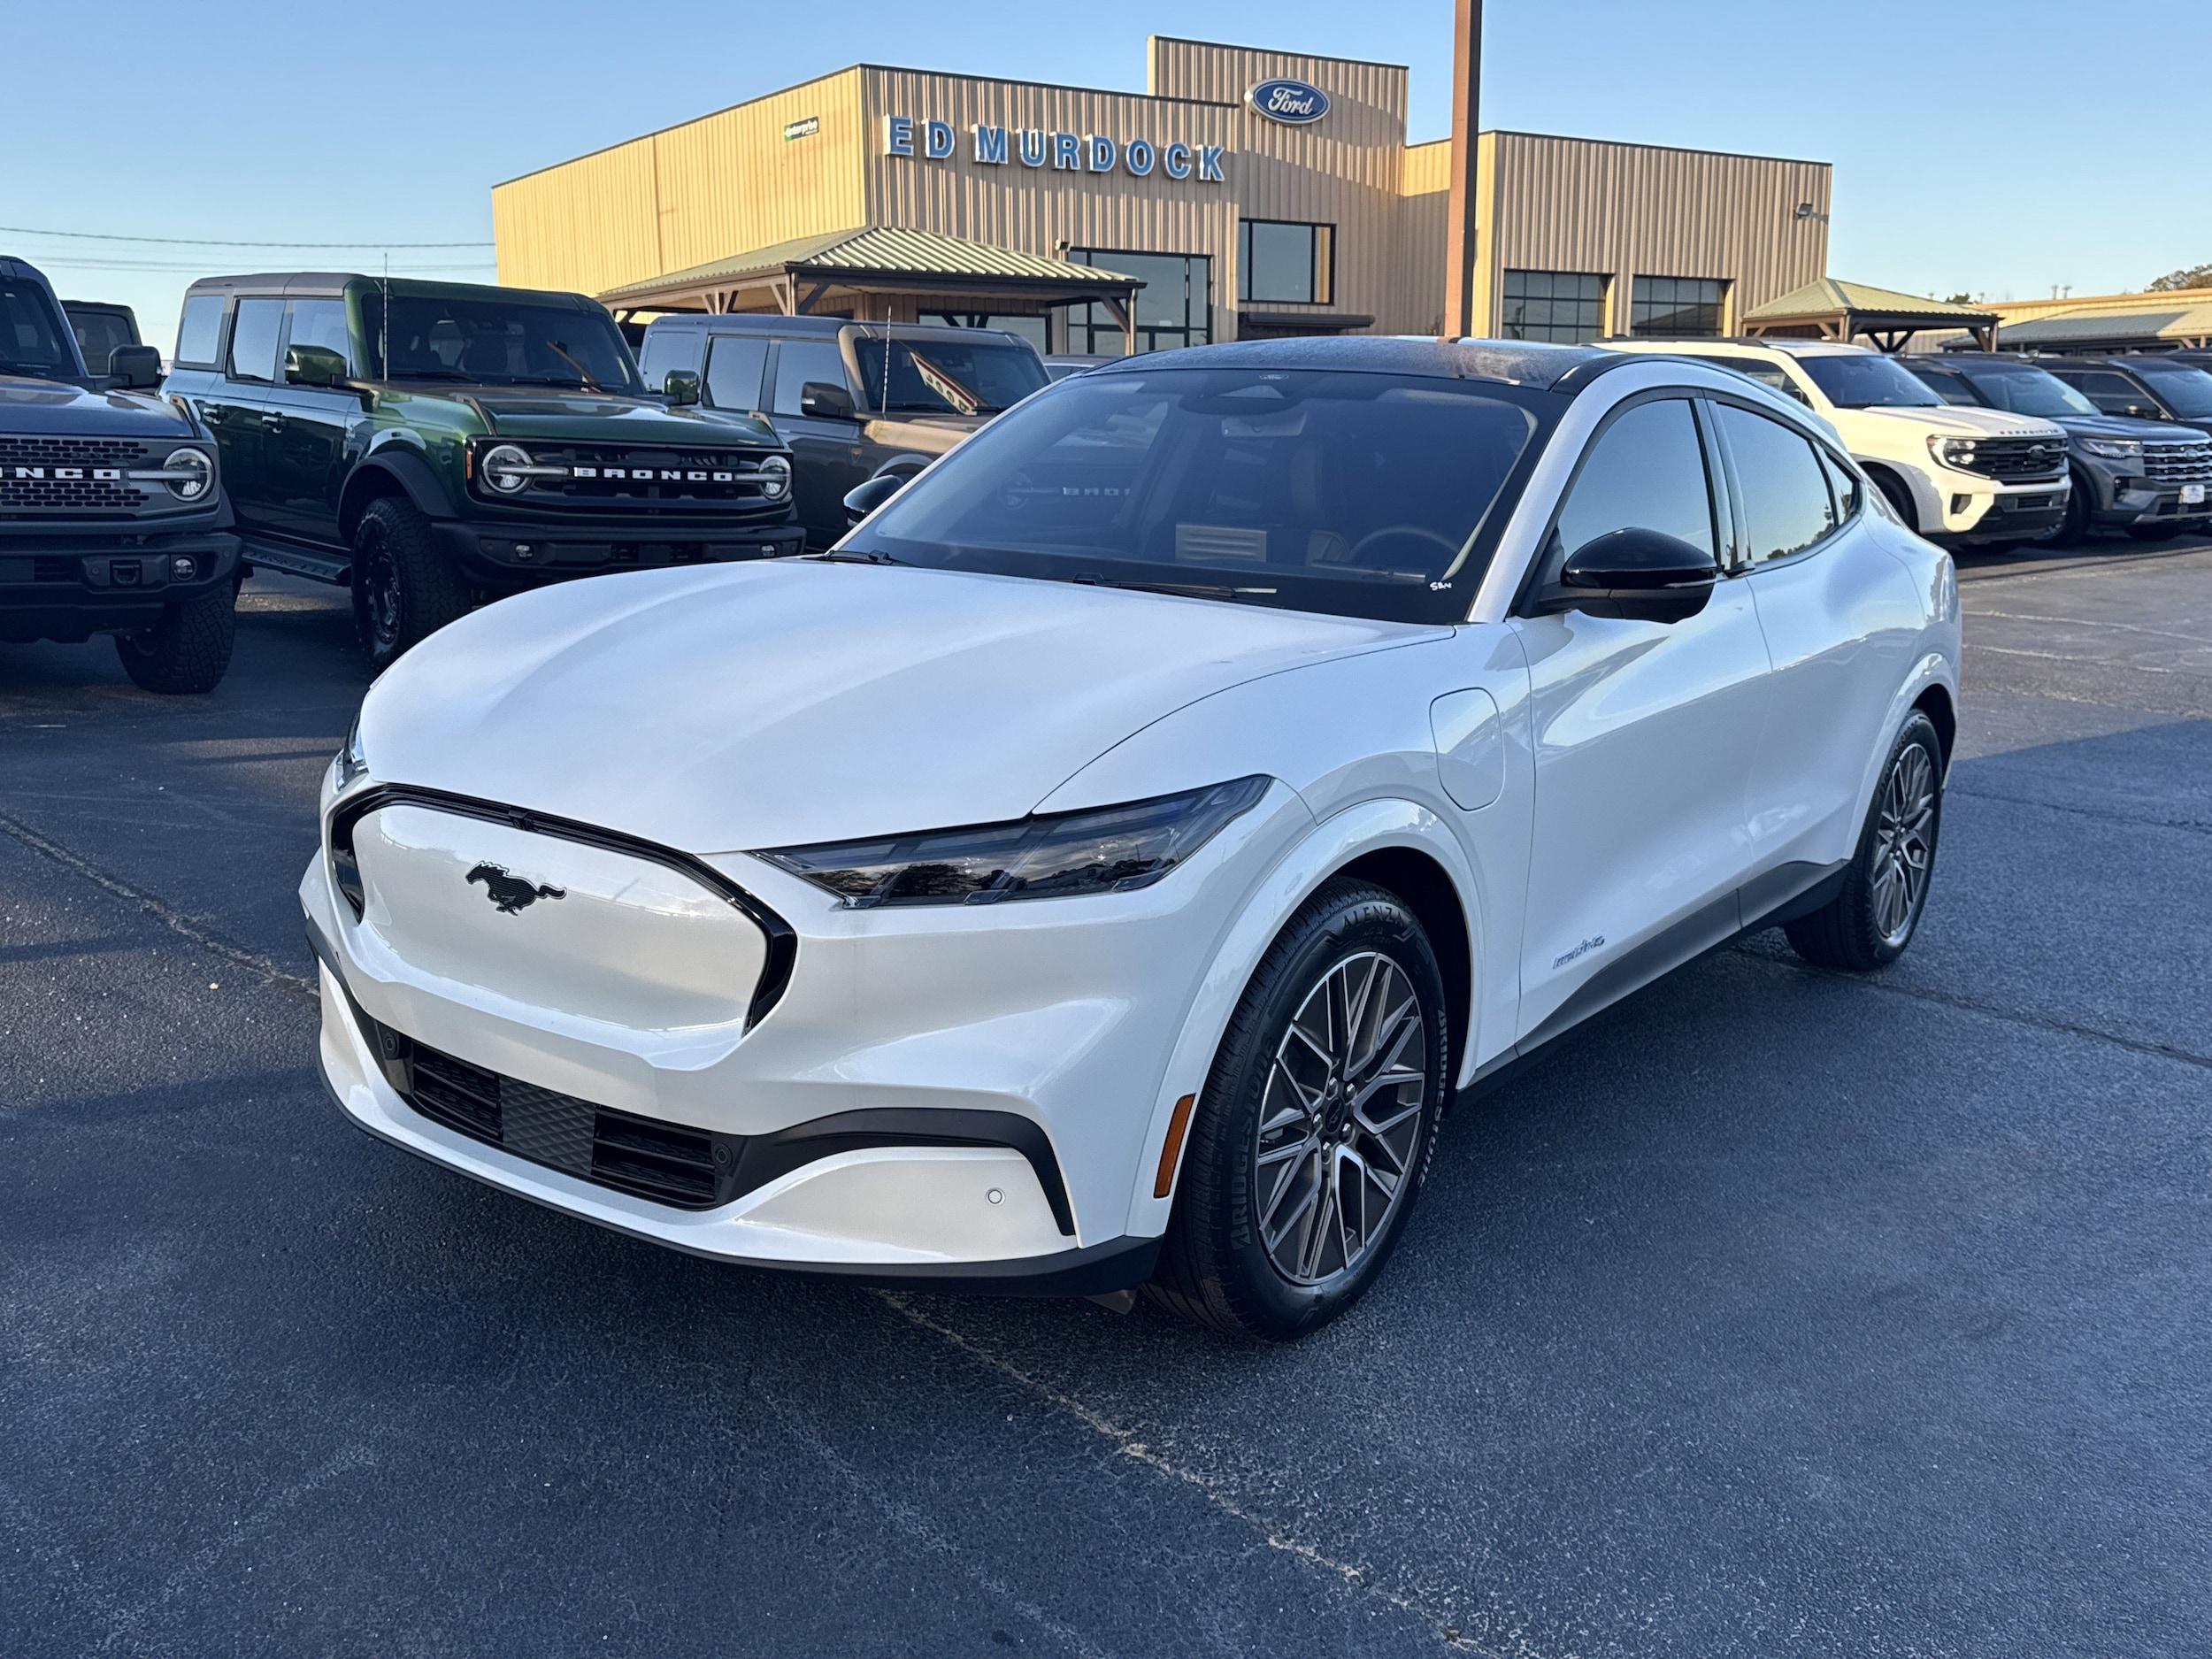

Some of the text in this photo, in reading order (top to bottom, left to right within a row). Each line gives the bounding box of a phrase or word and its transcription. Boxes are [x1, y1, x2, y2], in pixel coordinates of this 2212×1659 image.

[1268, 87, 1314, 115] Ford
[885, 113, 1225, 182] ED MURDOCK
[0, 466, 121, 480] NCO
[574, 466, 733, 482] BRONCO
[1343, 905, 1404, 929] ALENZA
